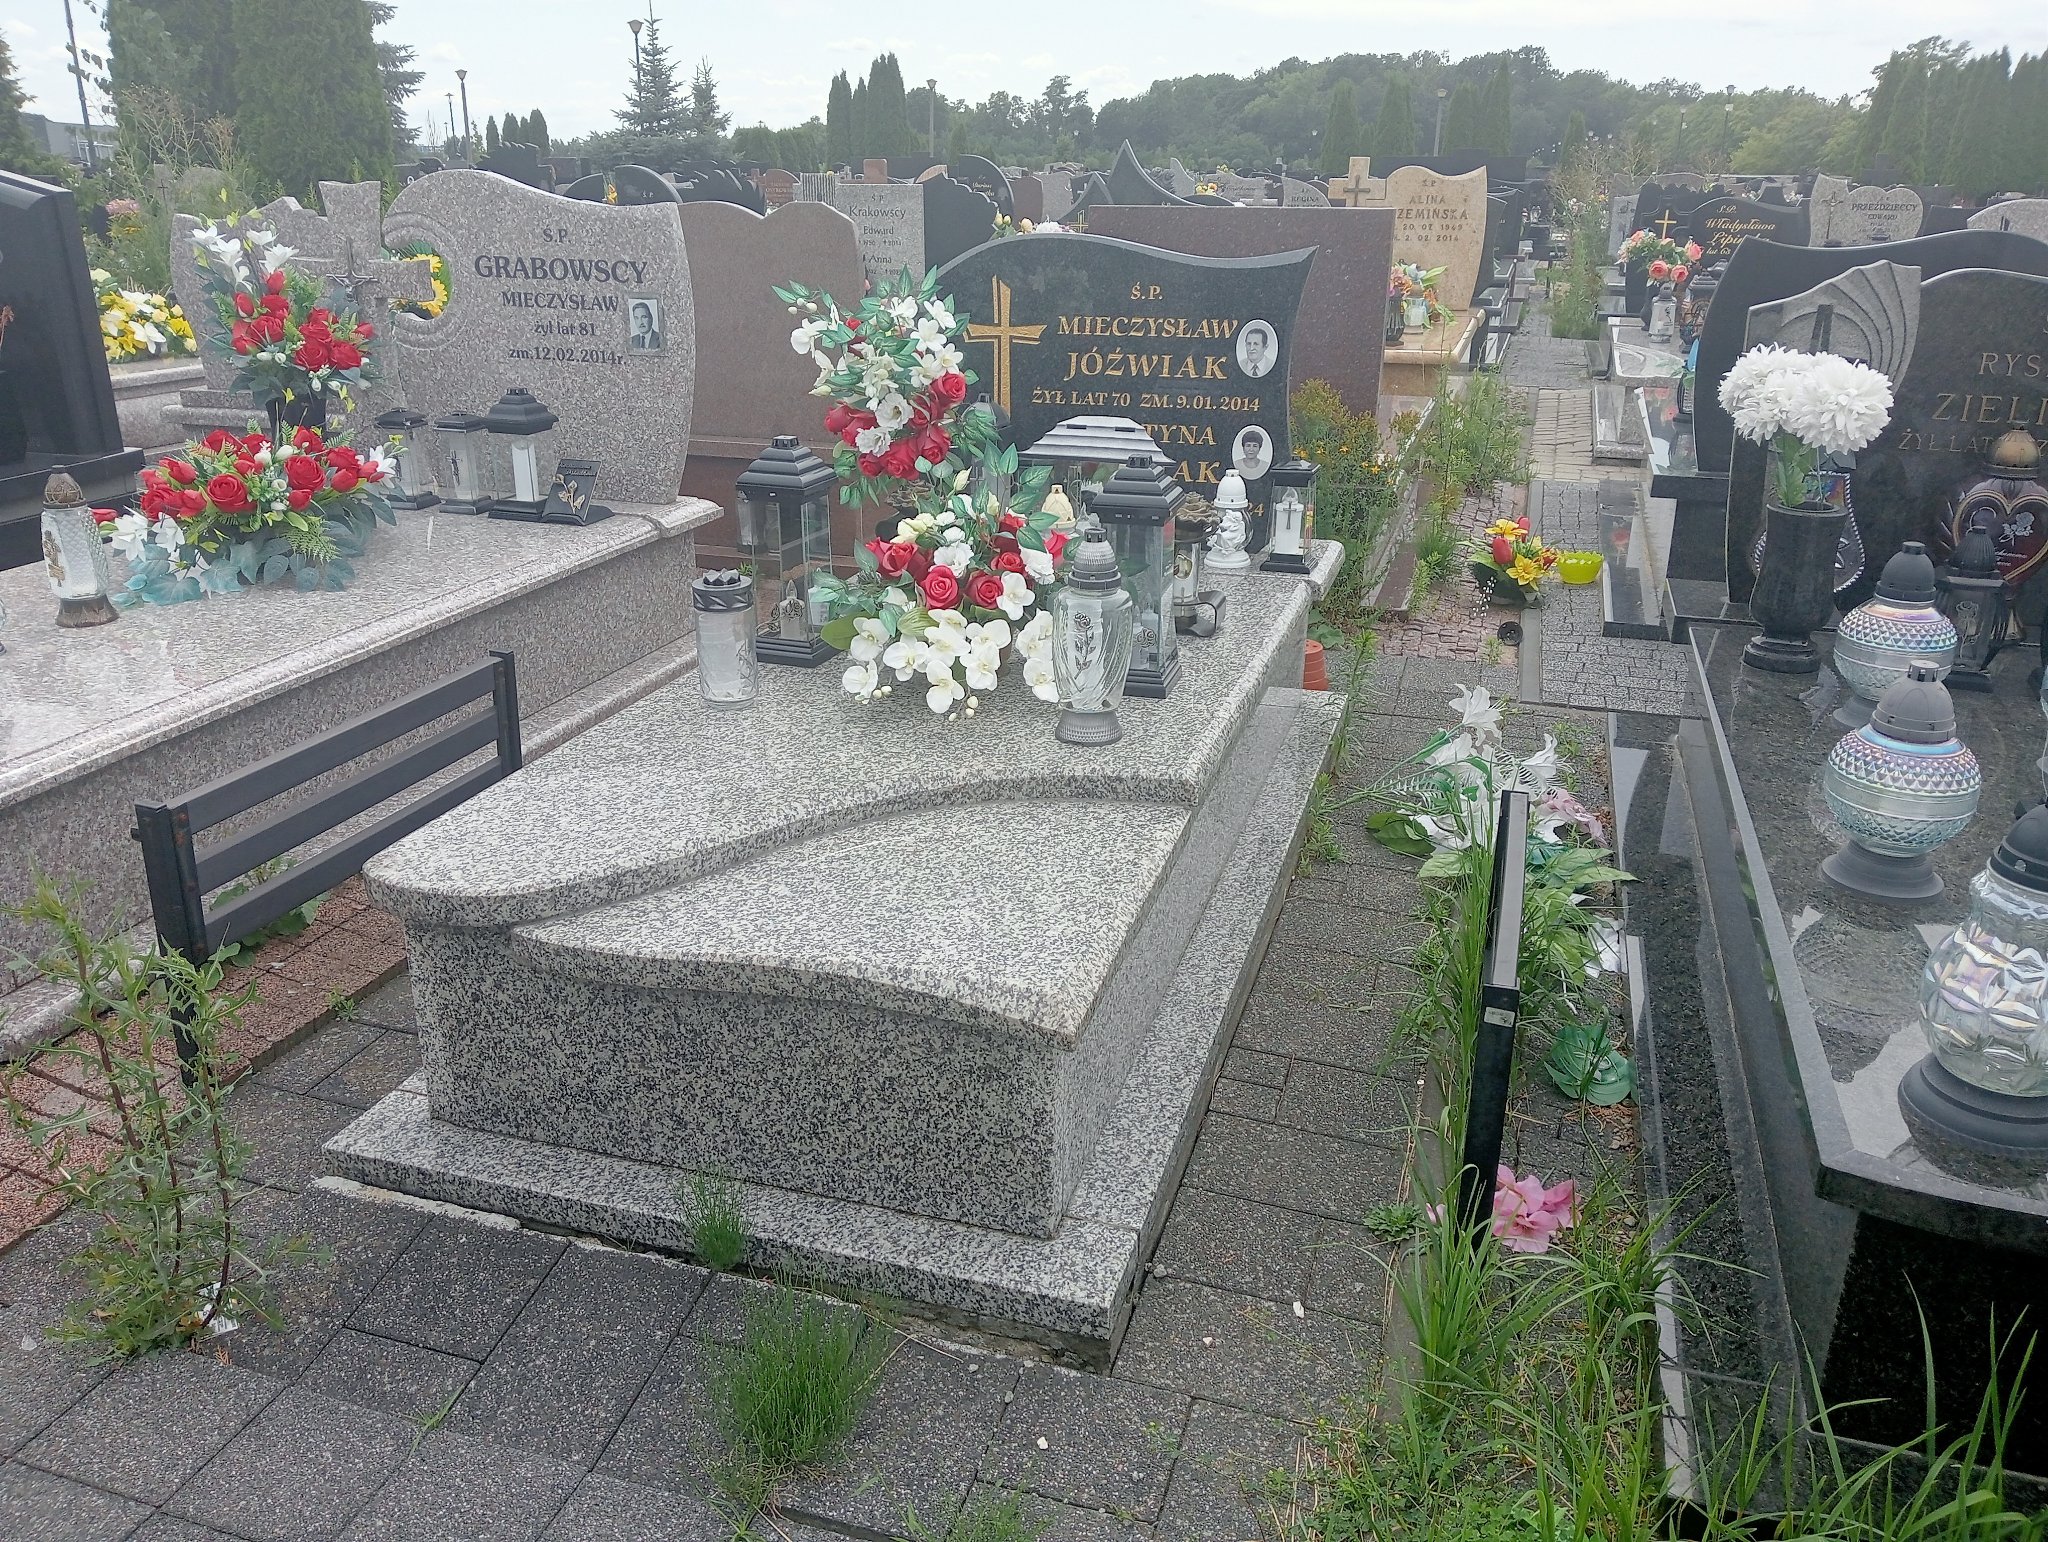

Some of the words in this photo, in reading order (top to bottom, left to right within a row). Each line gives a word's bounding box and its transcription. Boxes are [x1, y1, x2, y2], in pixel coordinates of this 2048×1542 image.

[1409, 195, 1446, 205] ALINA
[849, 205, 906, 220] Krakowscy
[863, 225, 894, 235] Edward
[1705, 217, 1776, 233] Władysława
[868, 253, 892, 264] Anna
[474, 254, 648, 284] GRABOWSCY
[501, 291, 619, 313] MIECZYSŁAW
[533, 321, 554, 337] żył
[556, 321, 576, 336] lat
[579, 323, 597, 336] 81
[1057, 315, 1239, 339] MIECZYSŁAW
[1063, 346, 1228, 382] JÓŹWIAK
[1032, 386, 1066, 405] ŻYŁ
[1071, 391, 1108, 406] LAT
[1112, 392, 1131, 407] 70
[1899, 428, 1938, 451] ŻYŁ
[1949, 435, 1993, 453] LAT
